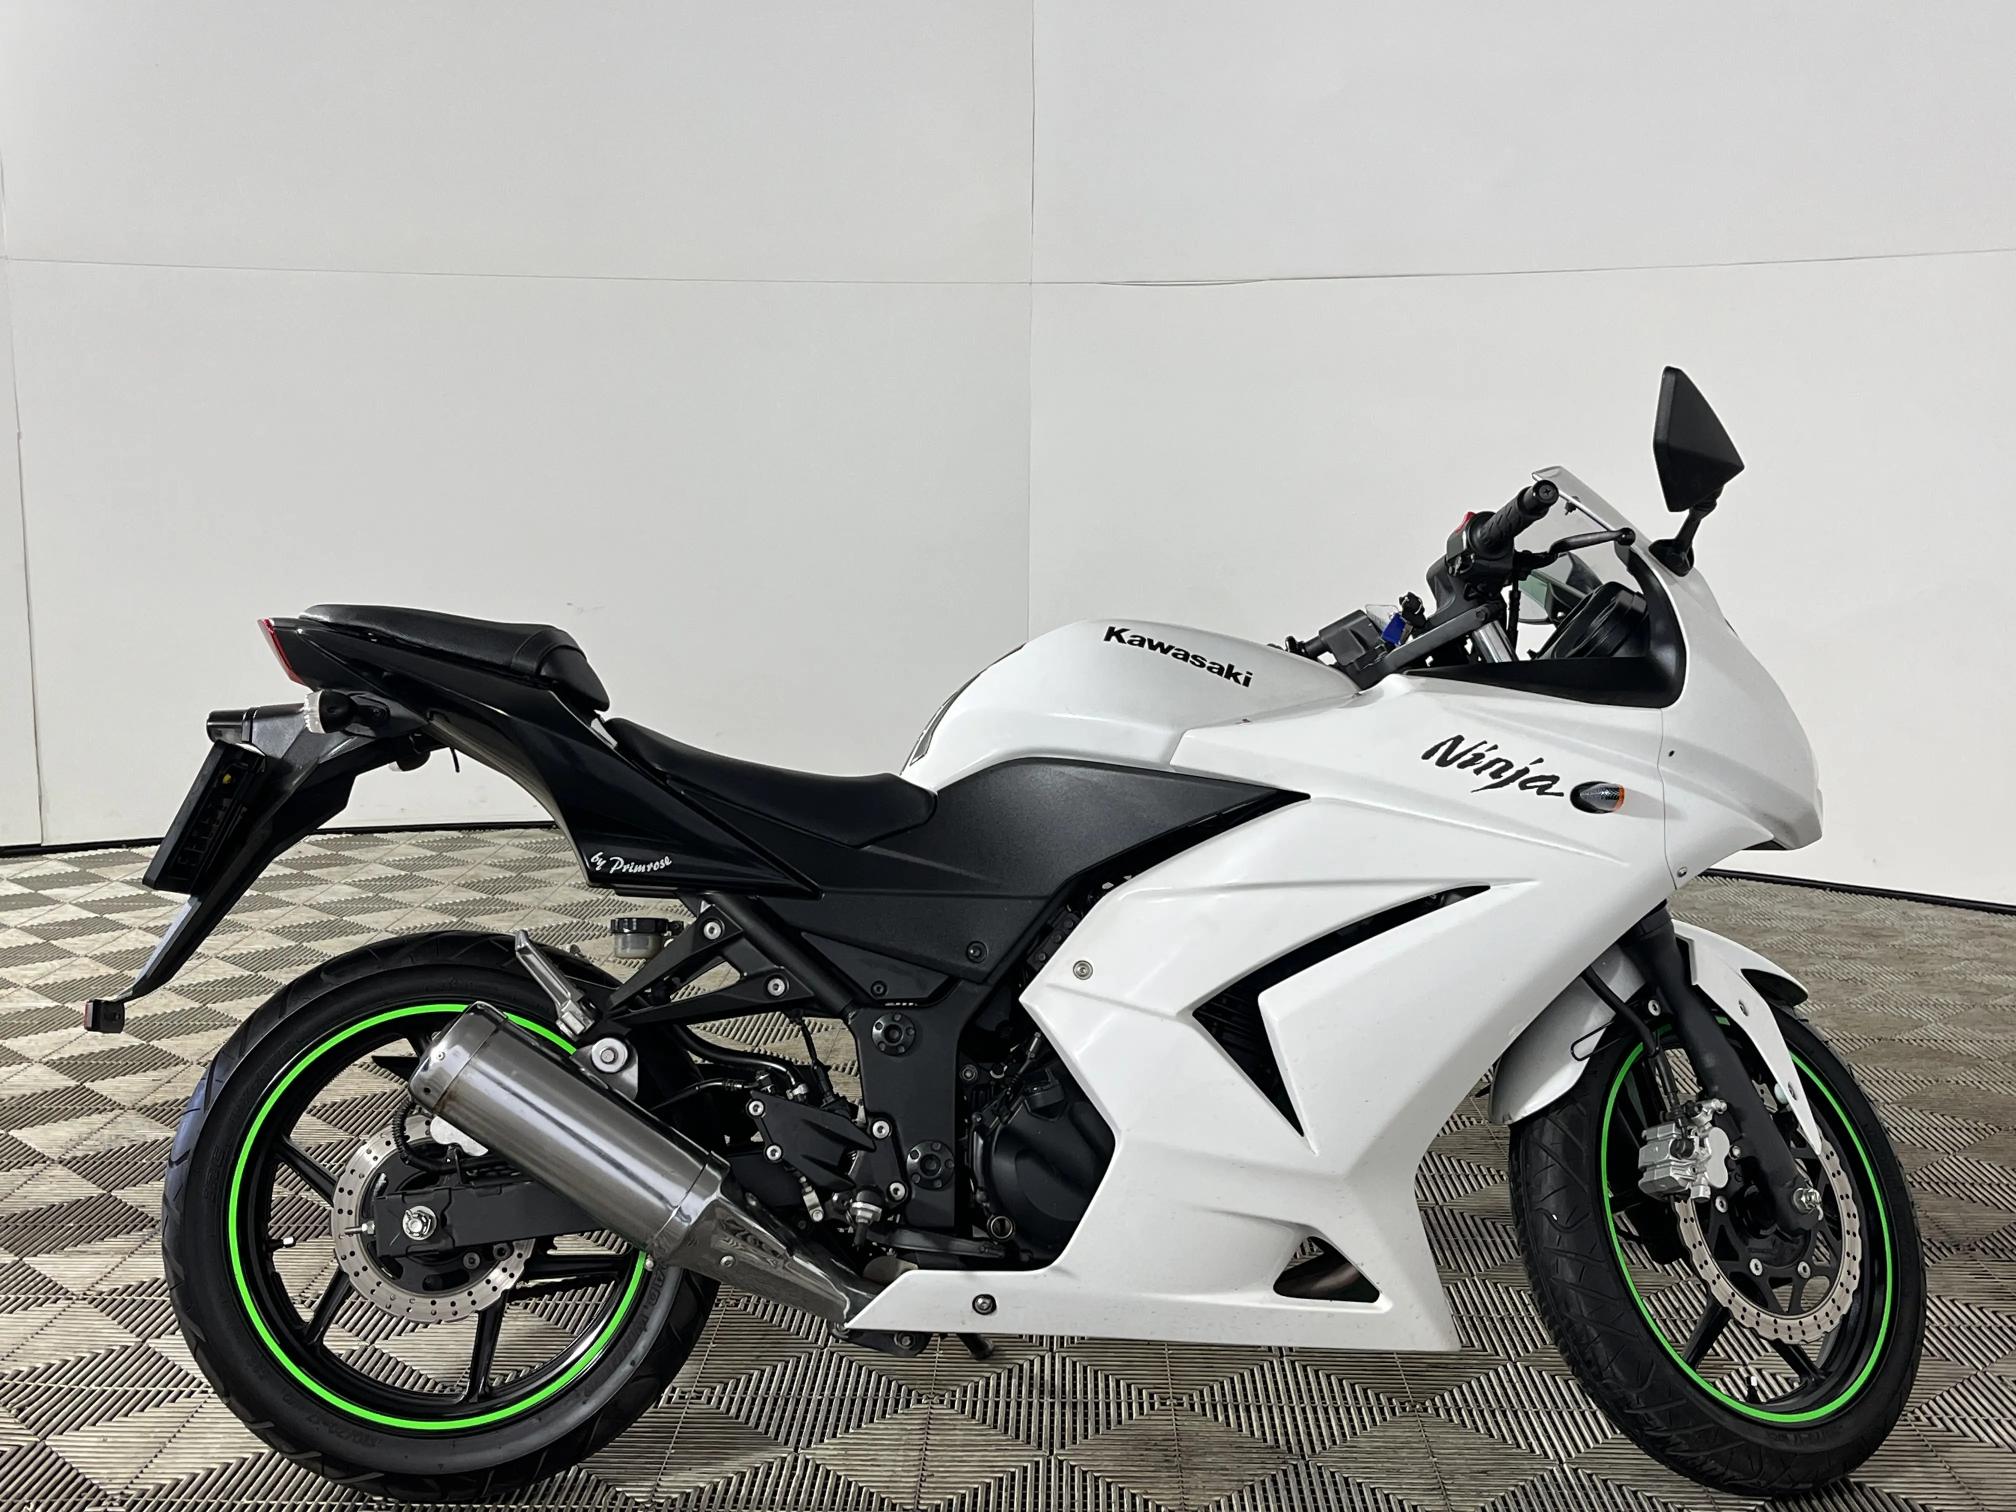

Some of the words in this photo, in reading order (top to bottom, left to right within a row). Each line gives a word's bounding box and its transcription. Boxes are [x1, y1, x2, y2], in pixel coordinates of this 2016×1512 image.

[1103, 626, 1253, 688] Kawasaki
[1421, 734, 1564, 797] Ninja
[590, 851, 607, 871] by
[609, 856, 672, 874] Primrose
